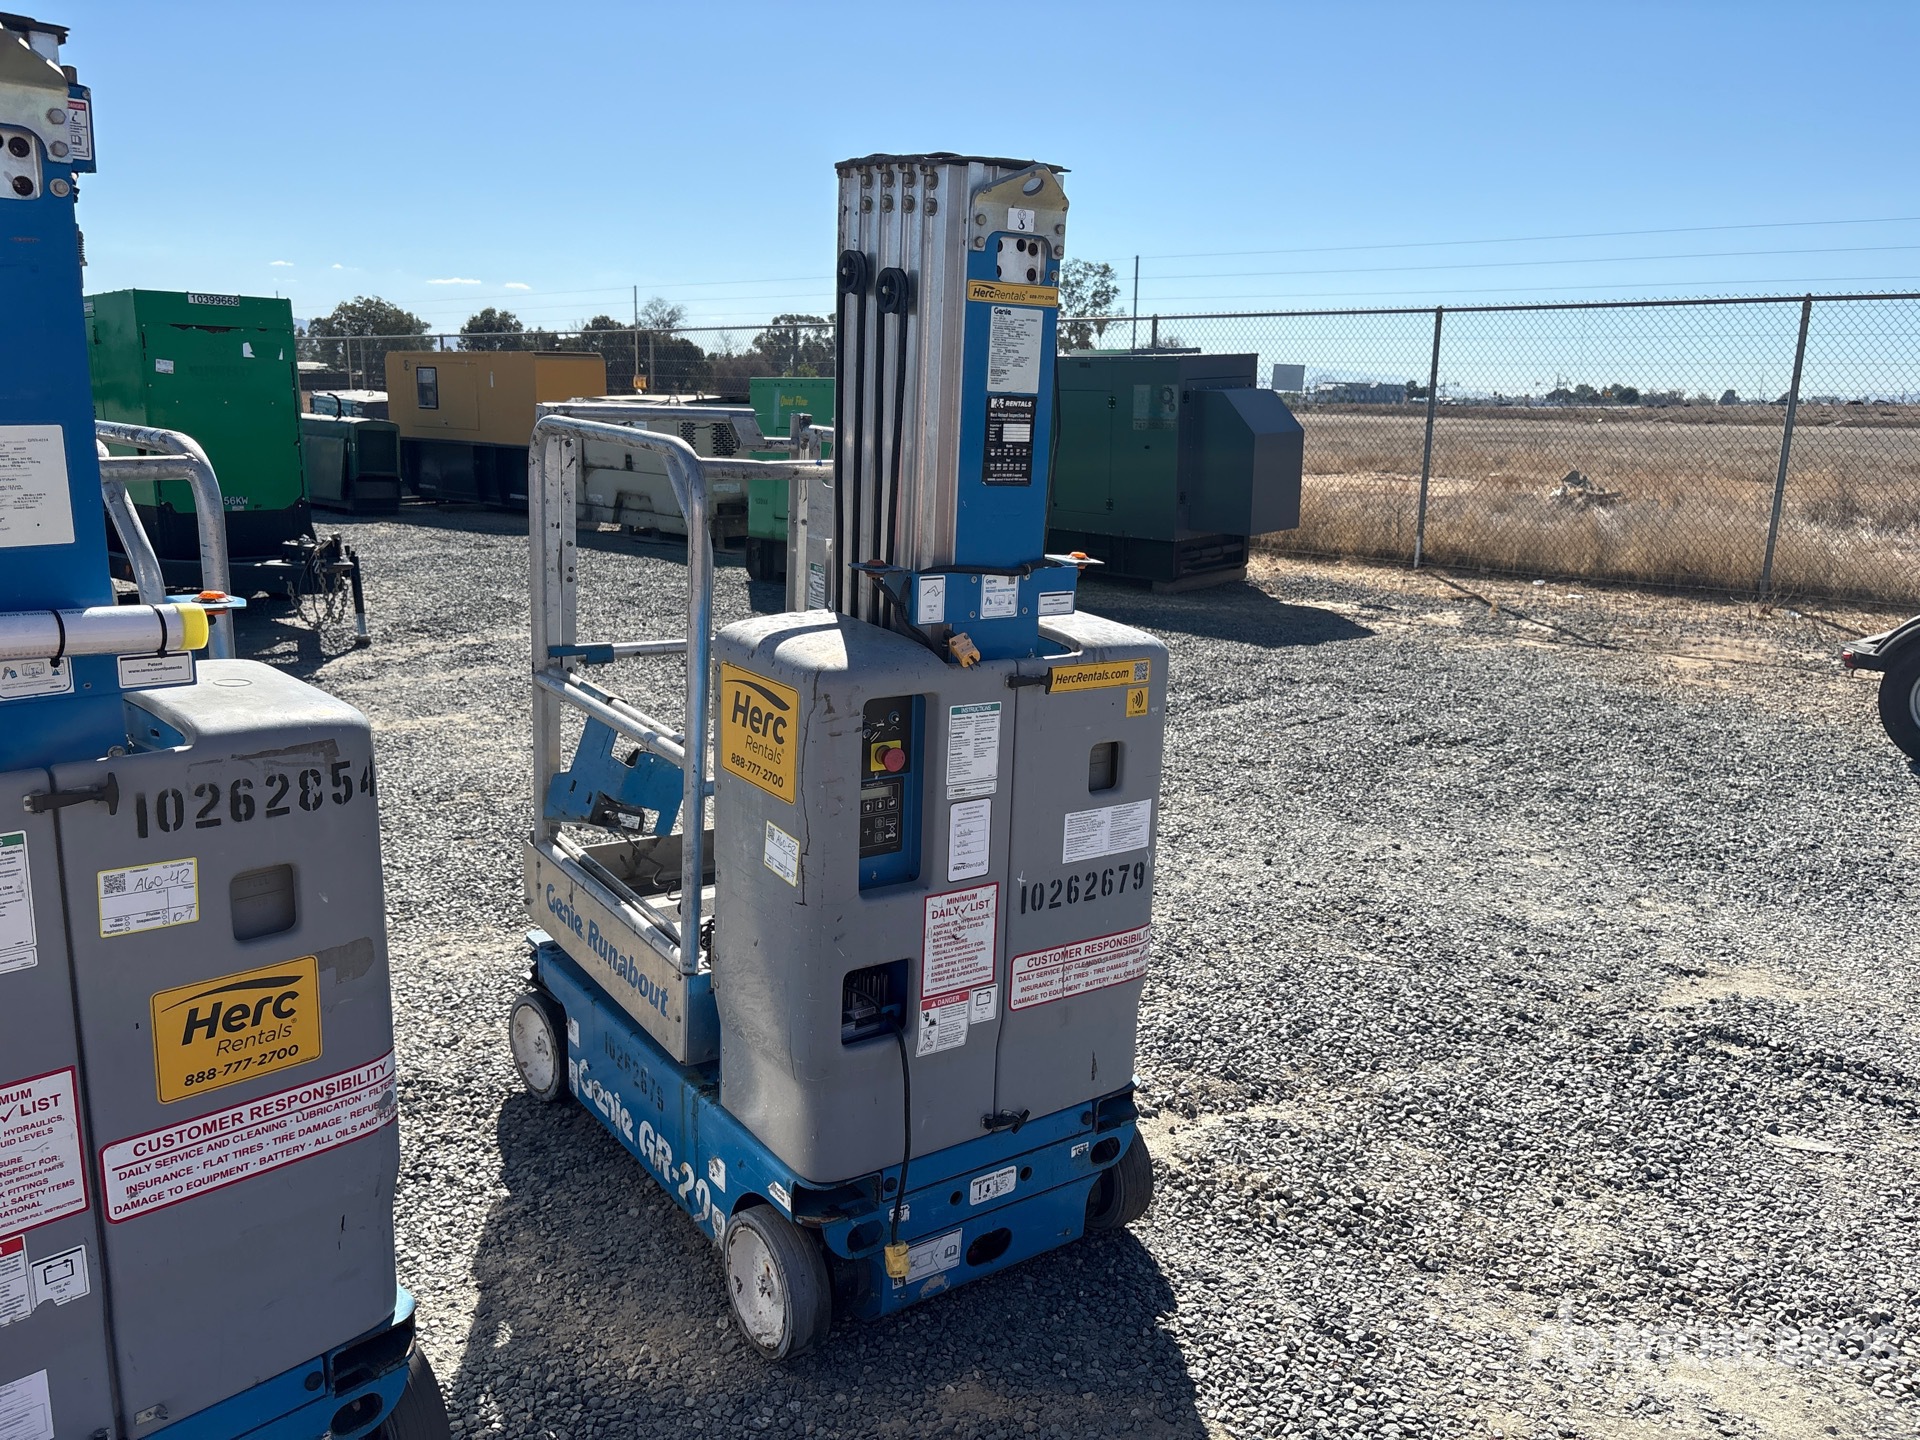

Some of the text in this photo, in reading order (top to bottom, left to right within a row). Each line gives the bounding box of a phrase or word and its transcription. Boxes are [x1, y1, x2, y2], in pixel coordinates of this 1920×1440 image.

[191, 294, 240, 306] 10399668
[993, 307, 1012, 316] Genie
[1005, 400, 1032, 408] RENTALS
[1055, 669, 1129, 685] HercRentals.com
[732, 690, 787, 745] Herc
[961, 705, 992, 713] INSTRUCTIONS
[745, 734, 782, 765] Rentals
[731, 753, 784, 788] 888-777-2700
[136, 758, 375, 839] 10262854
[1020, 861, 1145, 914] 10262679
[931, 899, 990, 920] DAILY LIST
[946, 893, 978, 906] MINIMUM
[546, 883, 584, 941] Genie
[933, 922, 950, 930] ENGINE
[967, 921, 984, 929] LEVELS
[932, 947, 953, 957] VISUALLY
[954, 942, 974, 952] INSPECT
[943, 938, 968, 948] PRESSURE
[587, 918, 668, 1018] Runabout
[957, 955, 978, 964] FITTINGS
[1026, 947, 1082, 968] CUSTOMER
[930, 976, 945, 984] ITEMS
[931, 969, 950, 977] ENSURE
[961, 962, 979, 970] SAFETY
[1018, 974, 1036, 983] DAILY
[1035, 967, 1062, 979] SERVICE
[1061, 964, 1073, 972] AND
[1020, 980, 1055, 993] INSURANCE
[1073, 971, 1089, 980] TIRES
[1093, 966, 1106, 975] TIRE
[1105, 960, 1129, 971] DAMAGE
[937, 995, 960, 1006] DANGER
[1013, 994, 1039, 1006] DAMAGE
[1085, 976, 1110, 987] BATTERY
[181, 991, 299, 1046] Herc
[216, 1023, 293, 1057] Rentals
[184, 1044, 299, 1087] 888-777-2700
[20, 1093, 62, 1117] LIST
[133, 1061, 387, 1157] CUSTOMER RESPONSIBILITY
[3, 1114, 65, 1137] HYDRAULICS,
[18, 1127, 54, 1144] LEVELS
[118, 1163, 153, 1181] DAILY
[154, 1146, 204, 1170] SERVICE
[206, 1138, 230, 1153] AND
[232, 1119, 287, 1144] CLEANING
[295, 1094, 361, 1124] LUBRICATION
[125, 1101, 380, 1195] INSURANCE FLAT TIRES TIRE DAMAGE REFUE
[0, 1154, 61, 1179] NSPECT FOR:
[15, 1169, 43, 1183] BROKEN
[44, 1162, 65, 1174] PARTS
[114, 1116, 378, 1215] DAMAGE TO EQUIPMENT BATTERY ALL OILS AND
[638, 1120, 711, 1221] GR-20
[7, 1178, 49, 1196] FITTINGS
[972, 1168, 1015, 1187] Emergency Lowering
[11, 1179, 75, 1206] SAFETY ITEMS
[0, 1201, 43, 1220] RATIONAL
[17, 1197, 83, 1223] FOR FULL INSTRUCTIONS
